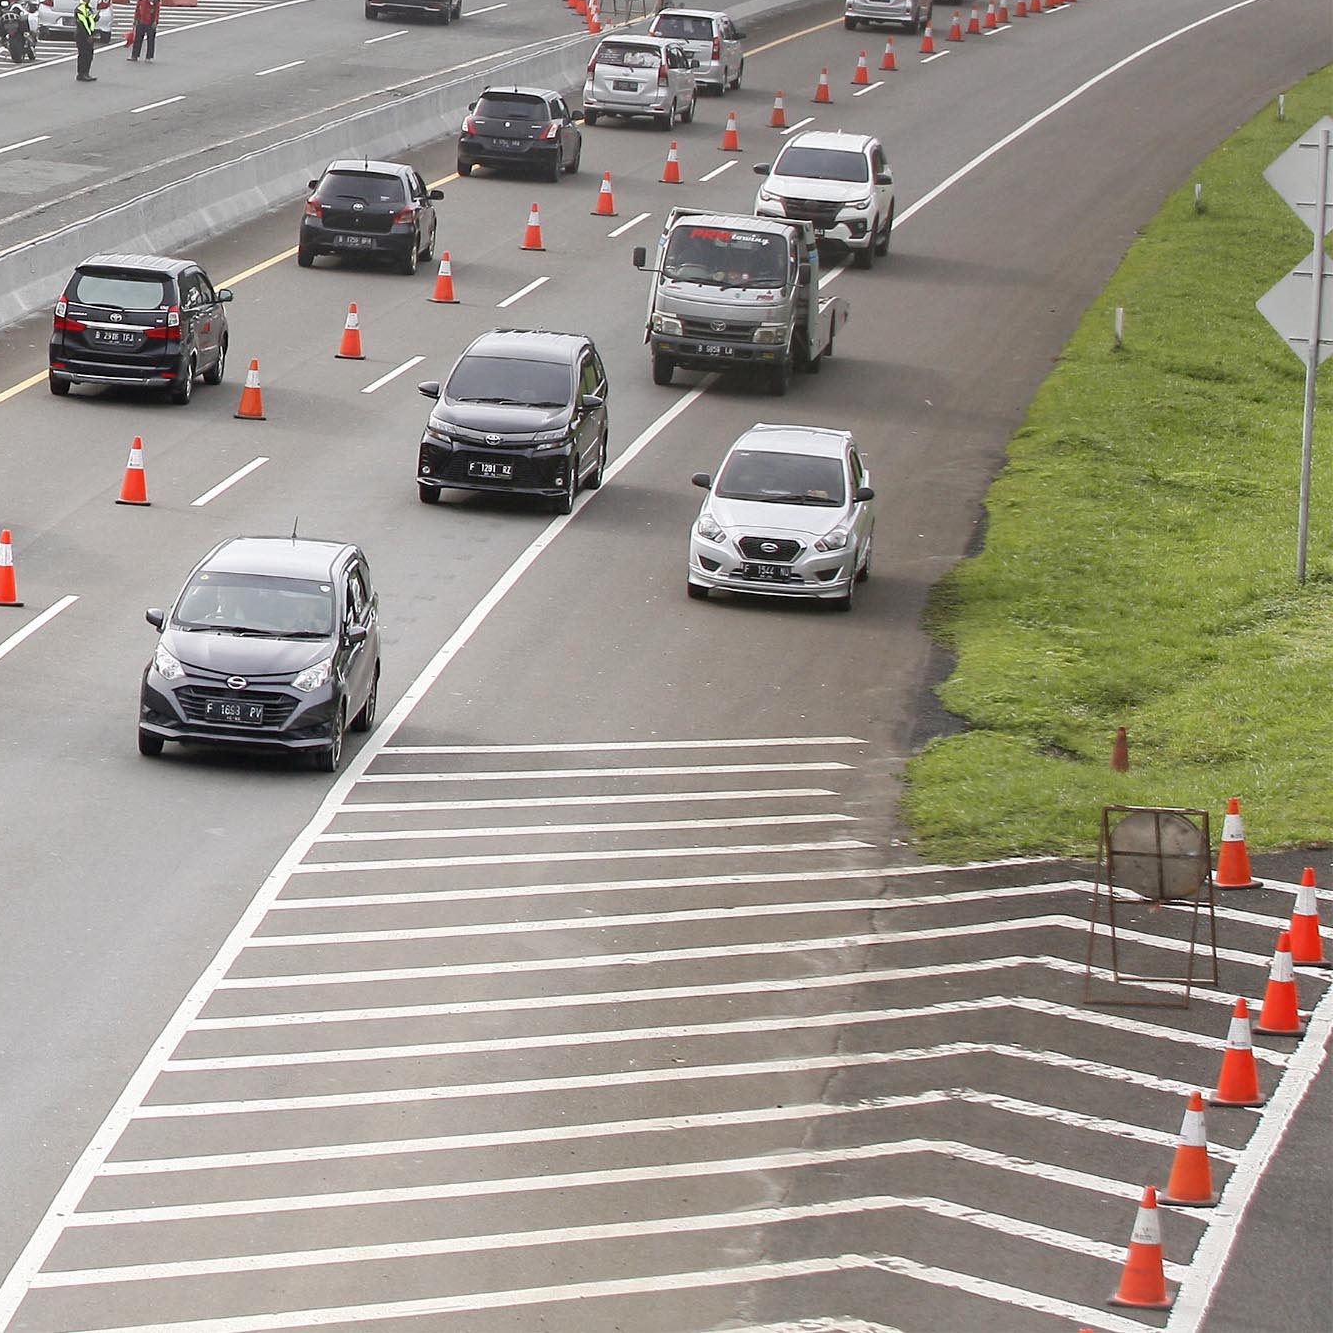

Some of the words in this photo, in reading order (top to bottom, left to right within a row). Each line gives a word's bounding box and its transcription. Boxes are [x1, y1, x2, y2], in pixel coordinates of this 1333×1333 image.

[732, 233, 770, 245] towing
[745, 564, 749, 572] F
[207, 703, 213, 713] F
[250, 707, 261, 718] PV
